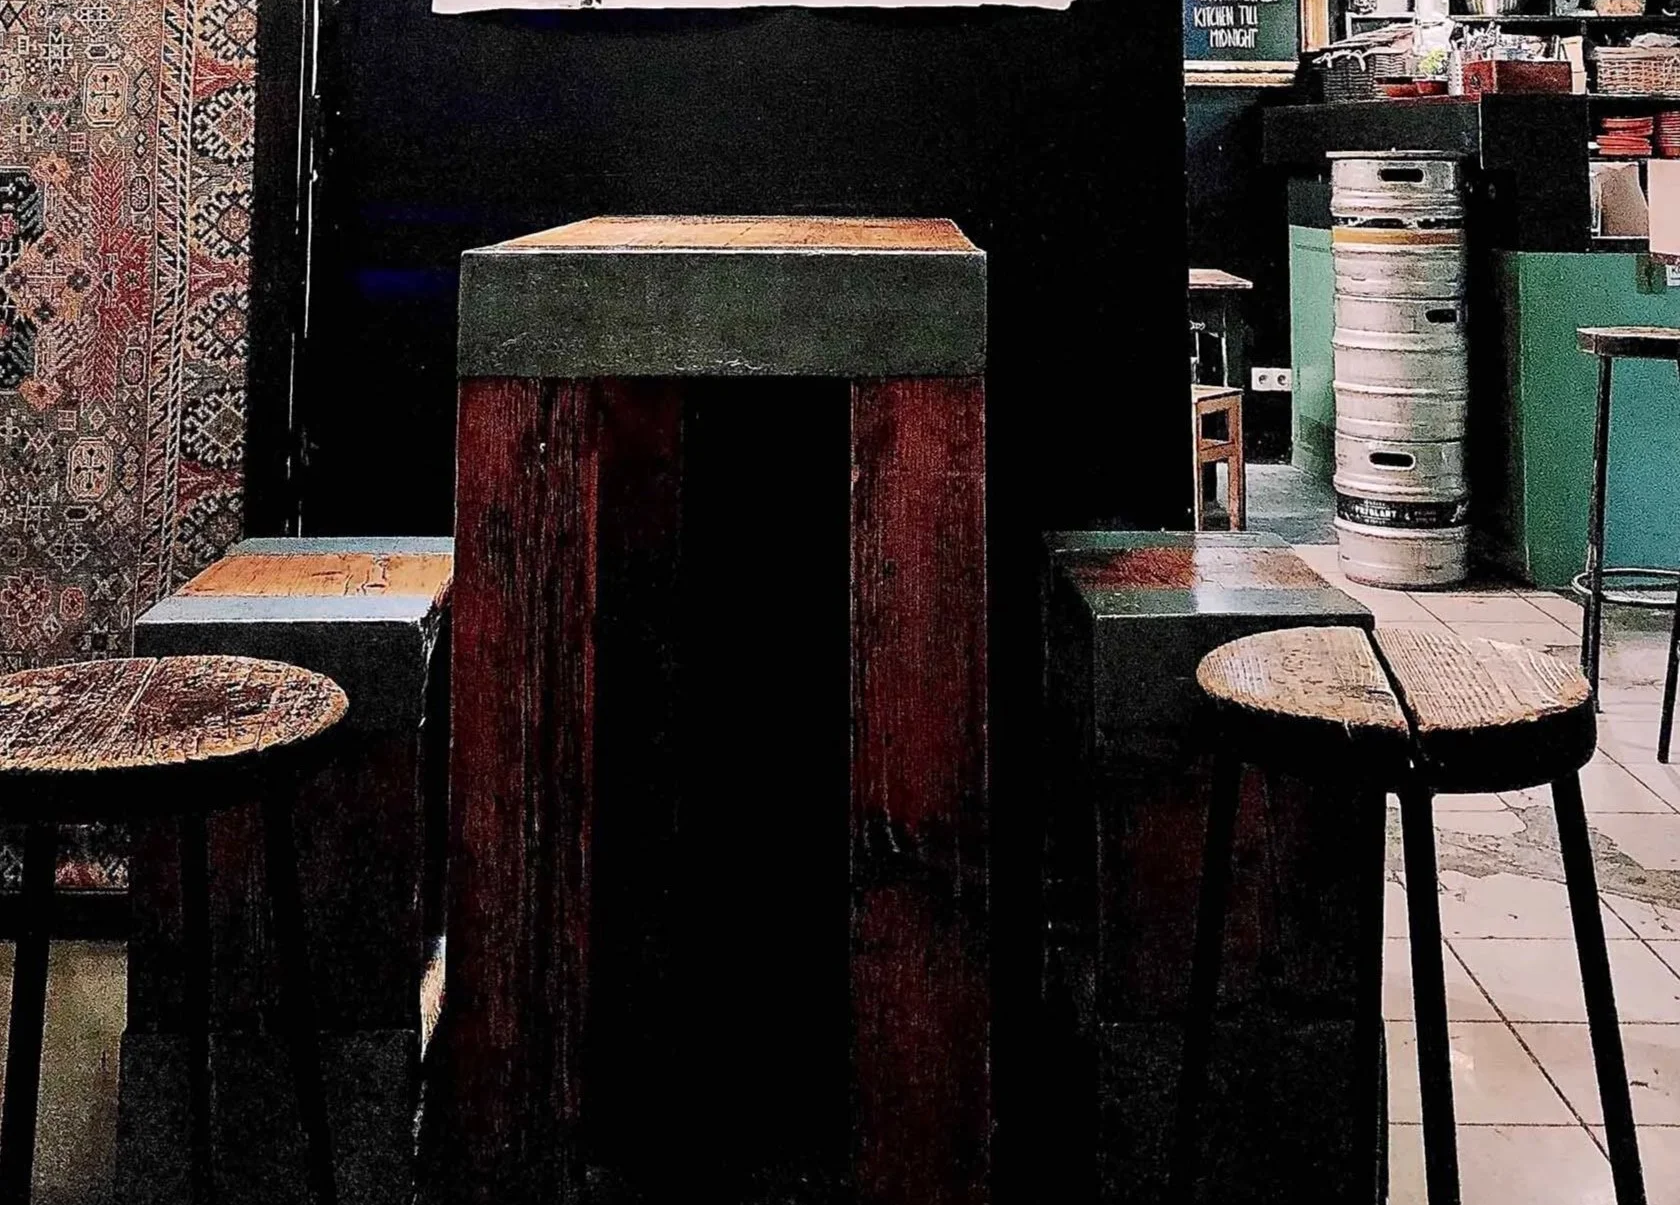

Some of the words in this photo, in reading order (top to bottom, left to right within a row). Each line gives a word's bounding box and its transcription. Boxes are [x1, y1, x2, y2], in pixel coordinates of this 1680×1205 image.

[1194, 5, 1233, 27] KITCHEN
[1239, 5, 1258, 25] TILL
[1210, 28, 1258, 48] MIDNIGHT
